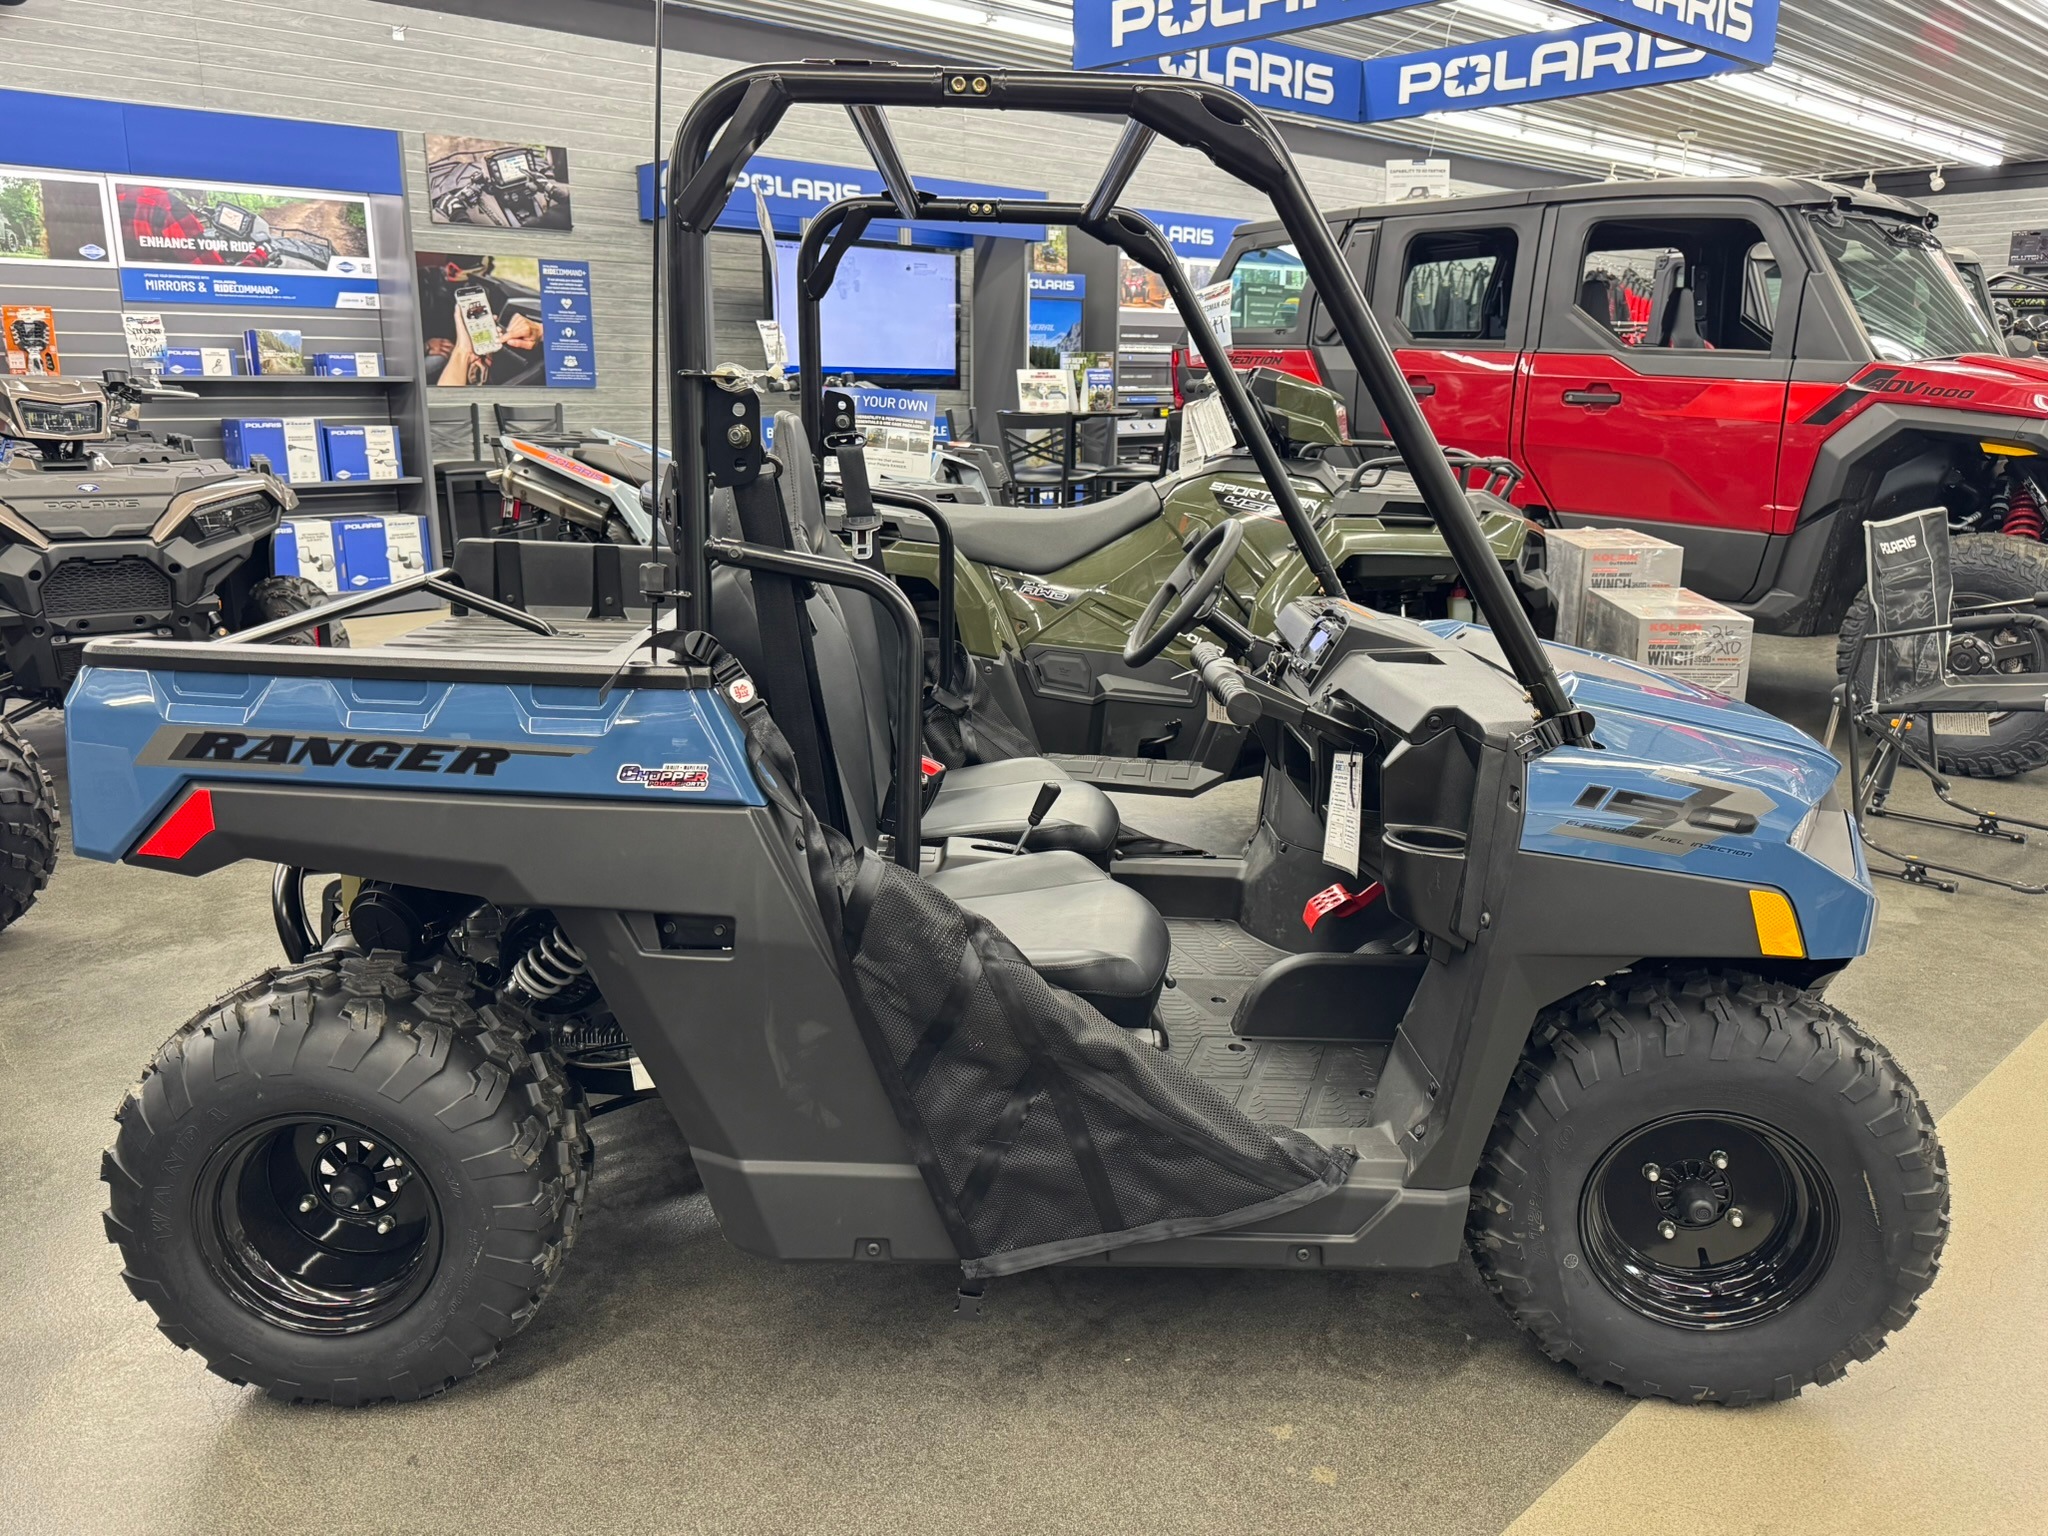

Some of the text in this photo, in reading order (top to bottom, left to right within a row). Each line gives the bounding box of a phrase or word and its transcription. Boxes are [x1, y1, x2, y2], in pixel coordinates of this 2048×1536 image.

[1158, 46, 1334, 105] OLARIS
[1398, 31, 1706, 105] POLARIS
[732, 173, 862, 201] POLARIS
[1160, 224, 1214, 245] LARIS
[139, 235, 256, 253] ENHANCE YOUR RIDE
[145, 279, 196, 292] MIRRORS
[198, 283, 207, 293] &
[1029, 279, 1075, 291] OLARIS
[1029, 323, 1055, 331] NERAL
[1228, 355, 1284, 365] PEDITION
[863, 396, 896, 409] YOUR
[898, 398, 928, 412] OWN
[546, 454, 604, 482] POLARIS
[44, 499, 140, 510] POLARIS
[344, 522, 383, 530] POLARIS
[1880, 535, 1917, 554] POLARIS
[1592, 553, 1638, 561] KOLPIN
[1591, 578, 1631, 588] WINCH
[1019, 584, 1069, 601] AWD
[1649, 623, 1702, 632] KOLPIN
[1648, 650, 1694, 666] WINCH
[186, 731, 511, 776] RANGER
[620, 765, 707, 782] CHOPPER
[648, 780, 706, 788] POWERSPORTS
[1566, 820, 1753, 858] ELECTRONIC FUEL INJECTION
